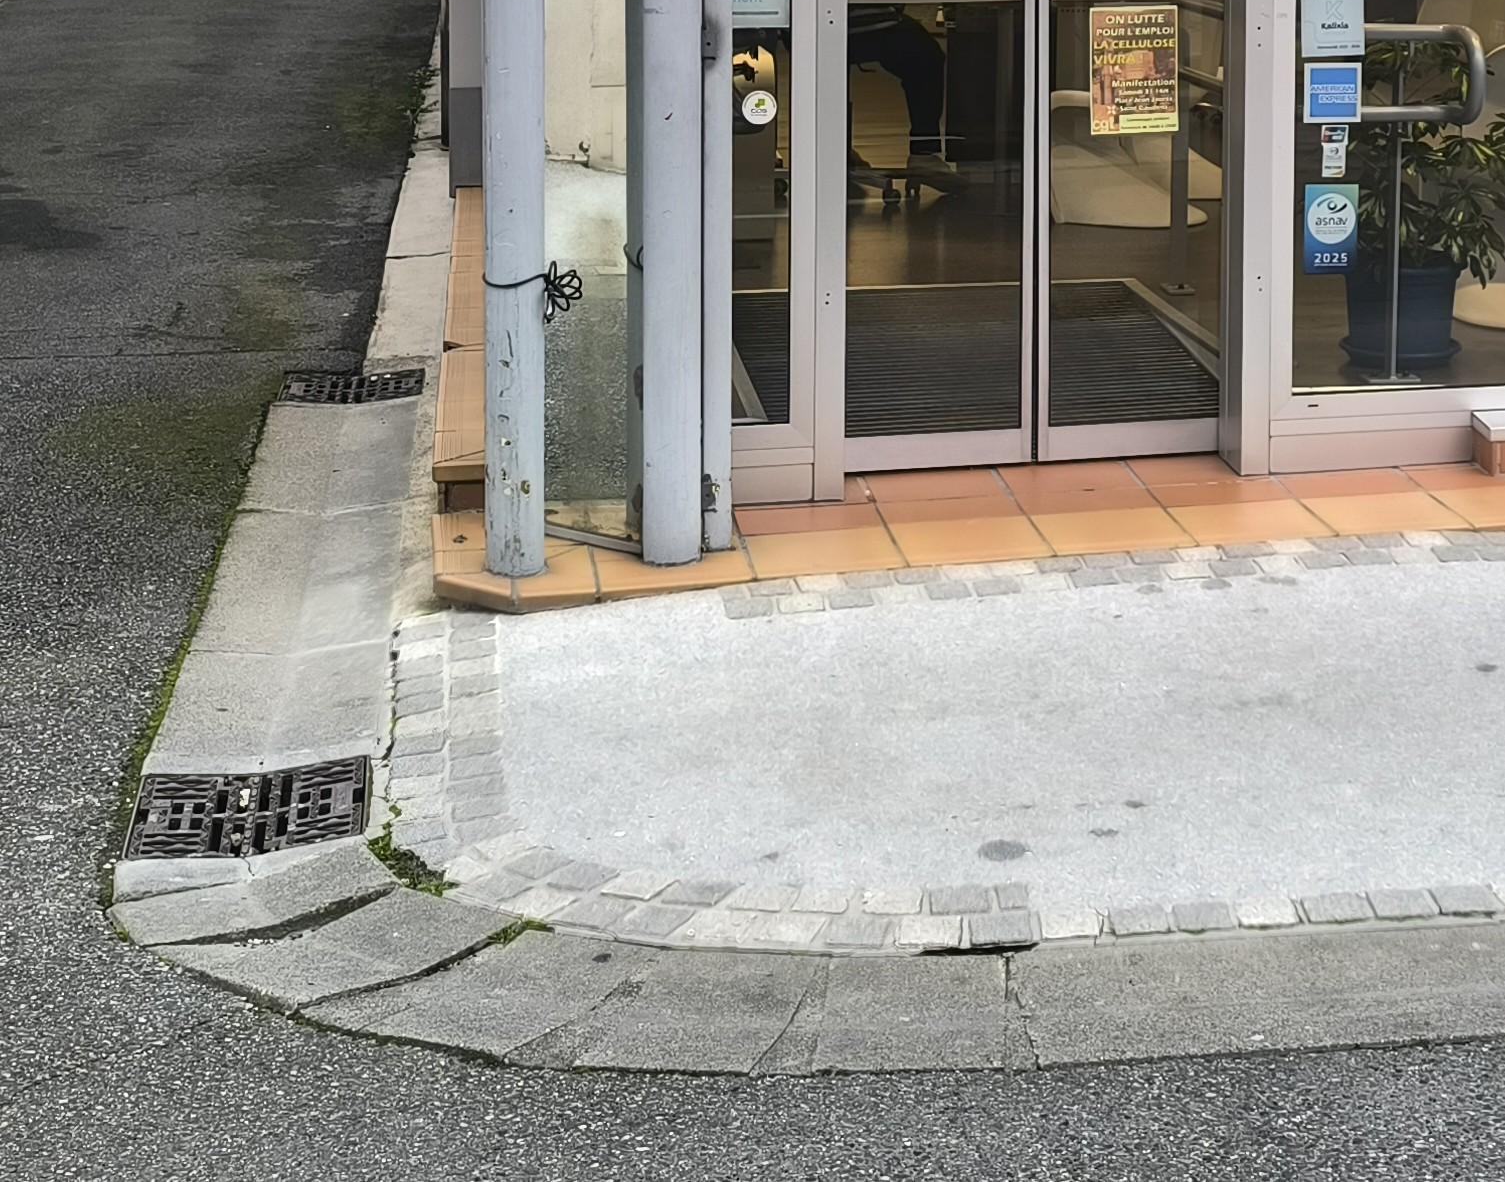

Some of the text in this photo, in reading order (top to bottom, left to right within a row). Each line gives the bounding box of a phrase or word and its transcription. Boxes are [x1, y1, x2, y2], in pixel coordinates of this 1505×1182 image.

[1106, 14, 1165, 24] ON LUTTE
[1096, 26, 1174, 36] POUR L'EMPLOI
[1094, 38, 1175, 49] LA CELLULOSE
[1093, 54, 1136, 65] VIVRA
[1310, 85, 1355, 93] AMERICAN
[1319, 95, 1358, 103] EXPRESS
[1315, 217, 1348, 226] asnav
[1314, 253, 1348, 263] 2025
